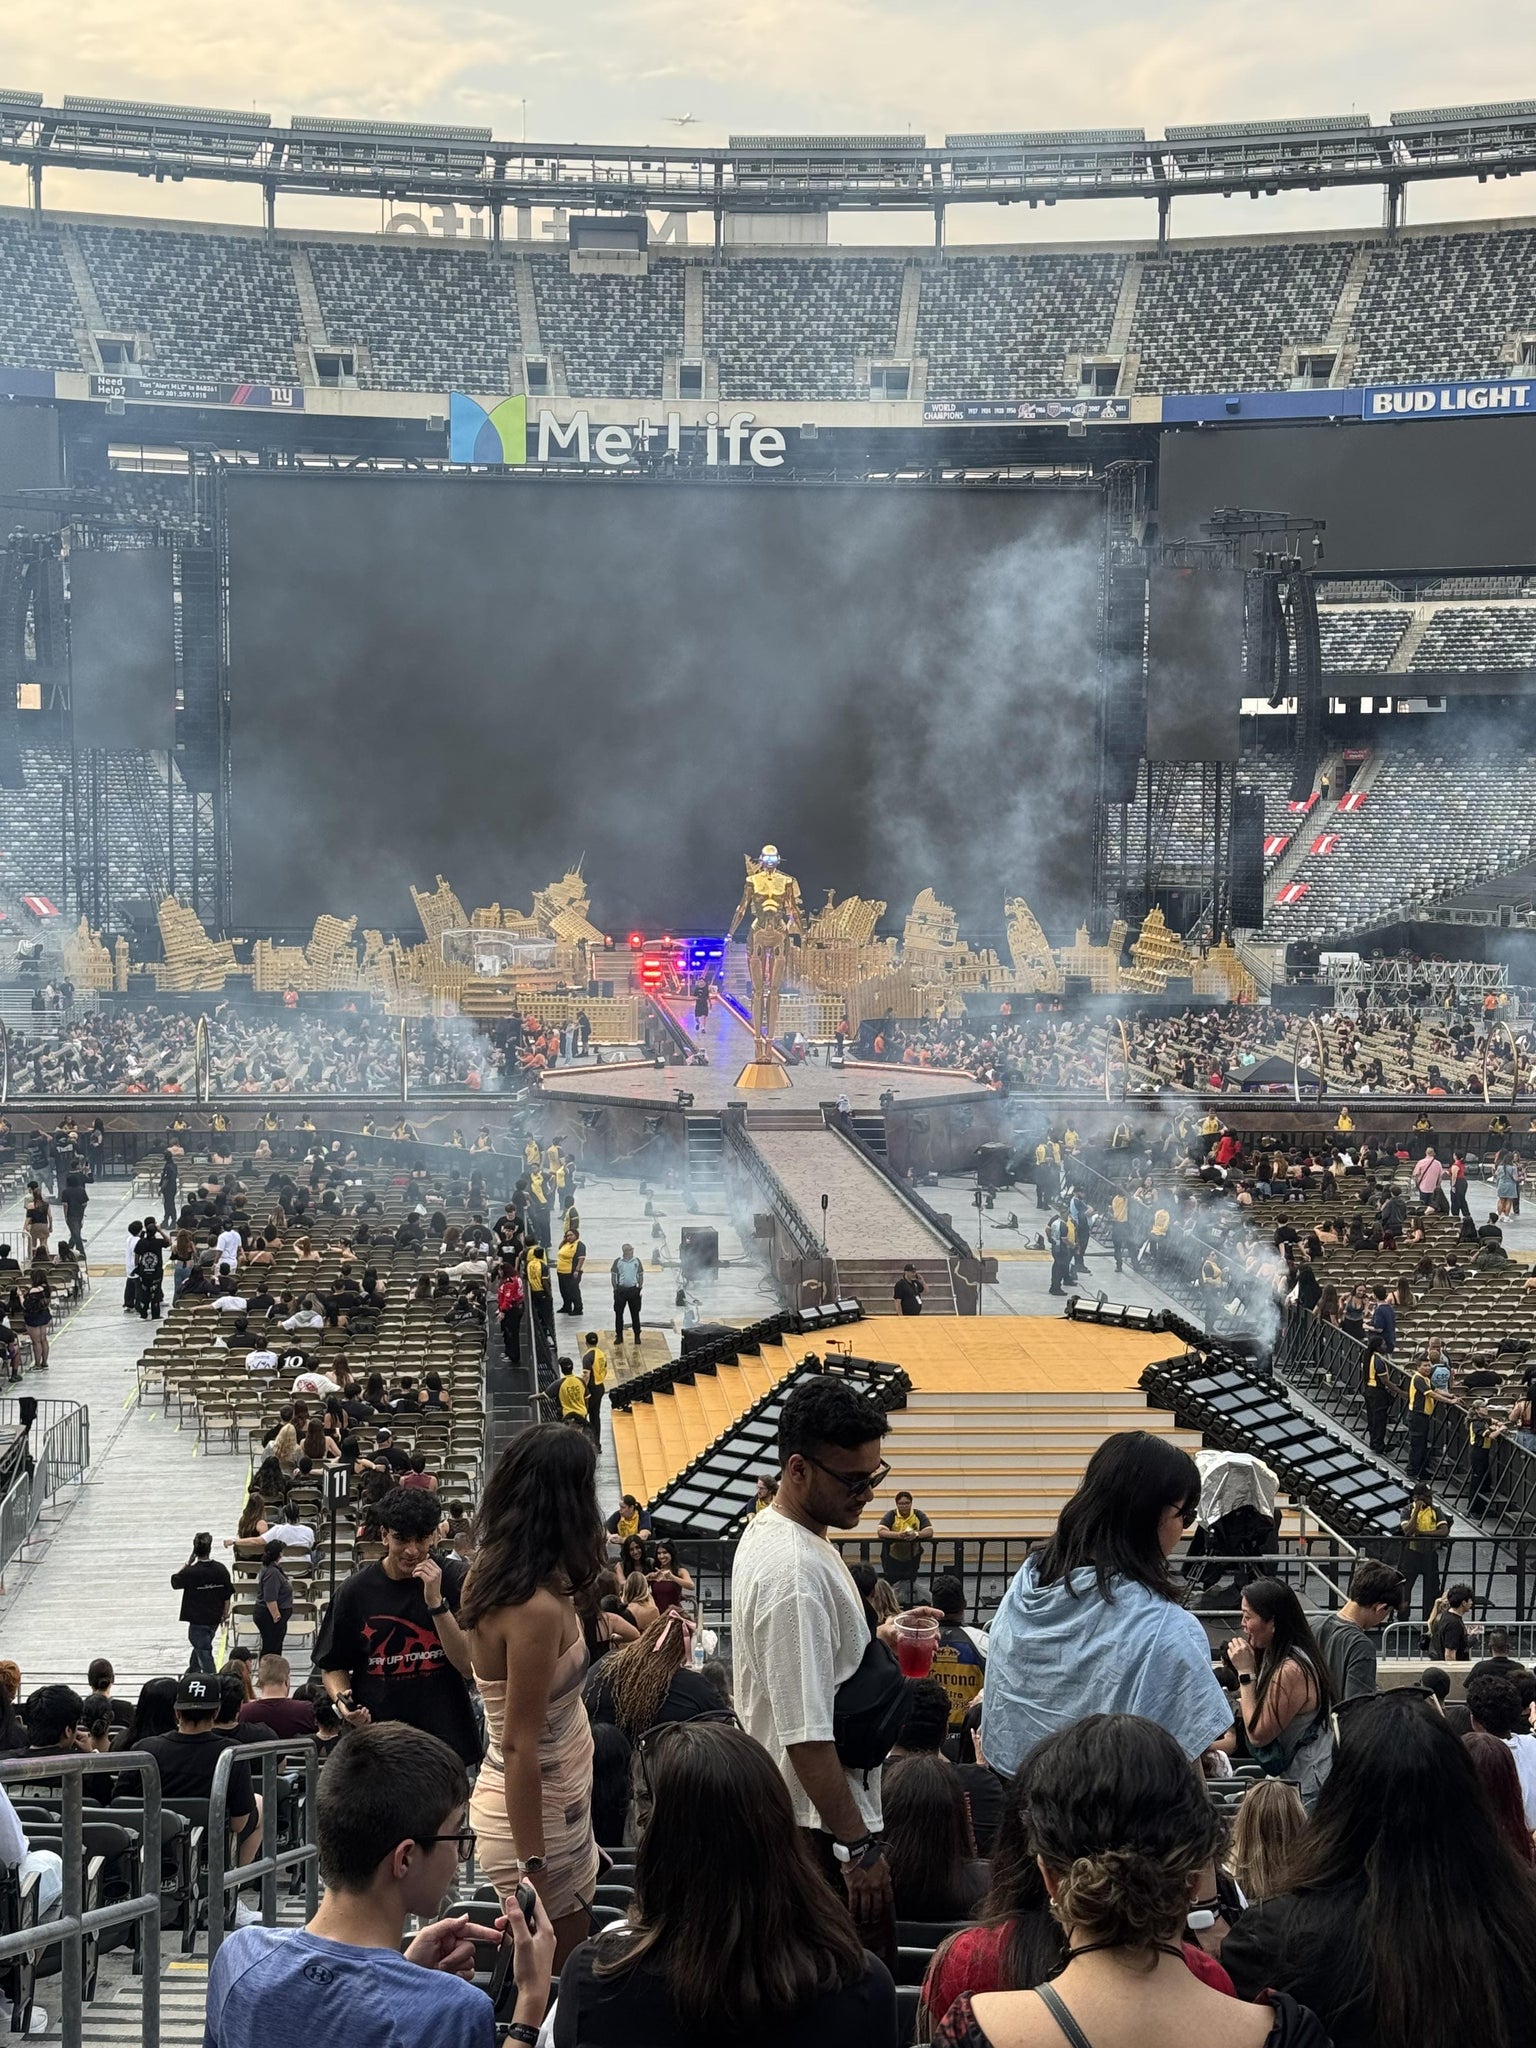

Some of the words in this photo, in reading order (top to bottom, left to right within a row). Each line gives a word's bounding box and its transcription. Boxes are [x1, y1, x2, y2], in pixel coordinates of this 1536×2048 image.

[98, 376, 123, 386] Need
[98, 386, 126, 397] Help?
[931, 403, 956, 412] WORLD
[1373, 391, 1436, 414] BUD
[924, 411, 964, 420] CHAMPIONS
[283, 1356, 304, 1368] 10
[334, 1470, 346, 1498] 11
[387, 1655, 404, 1665] UP
[404, 1648, 445, 1662] TOMORR
